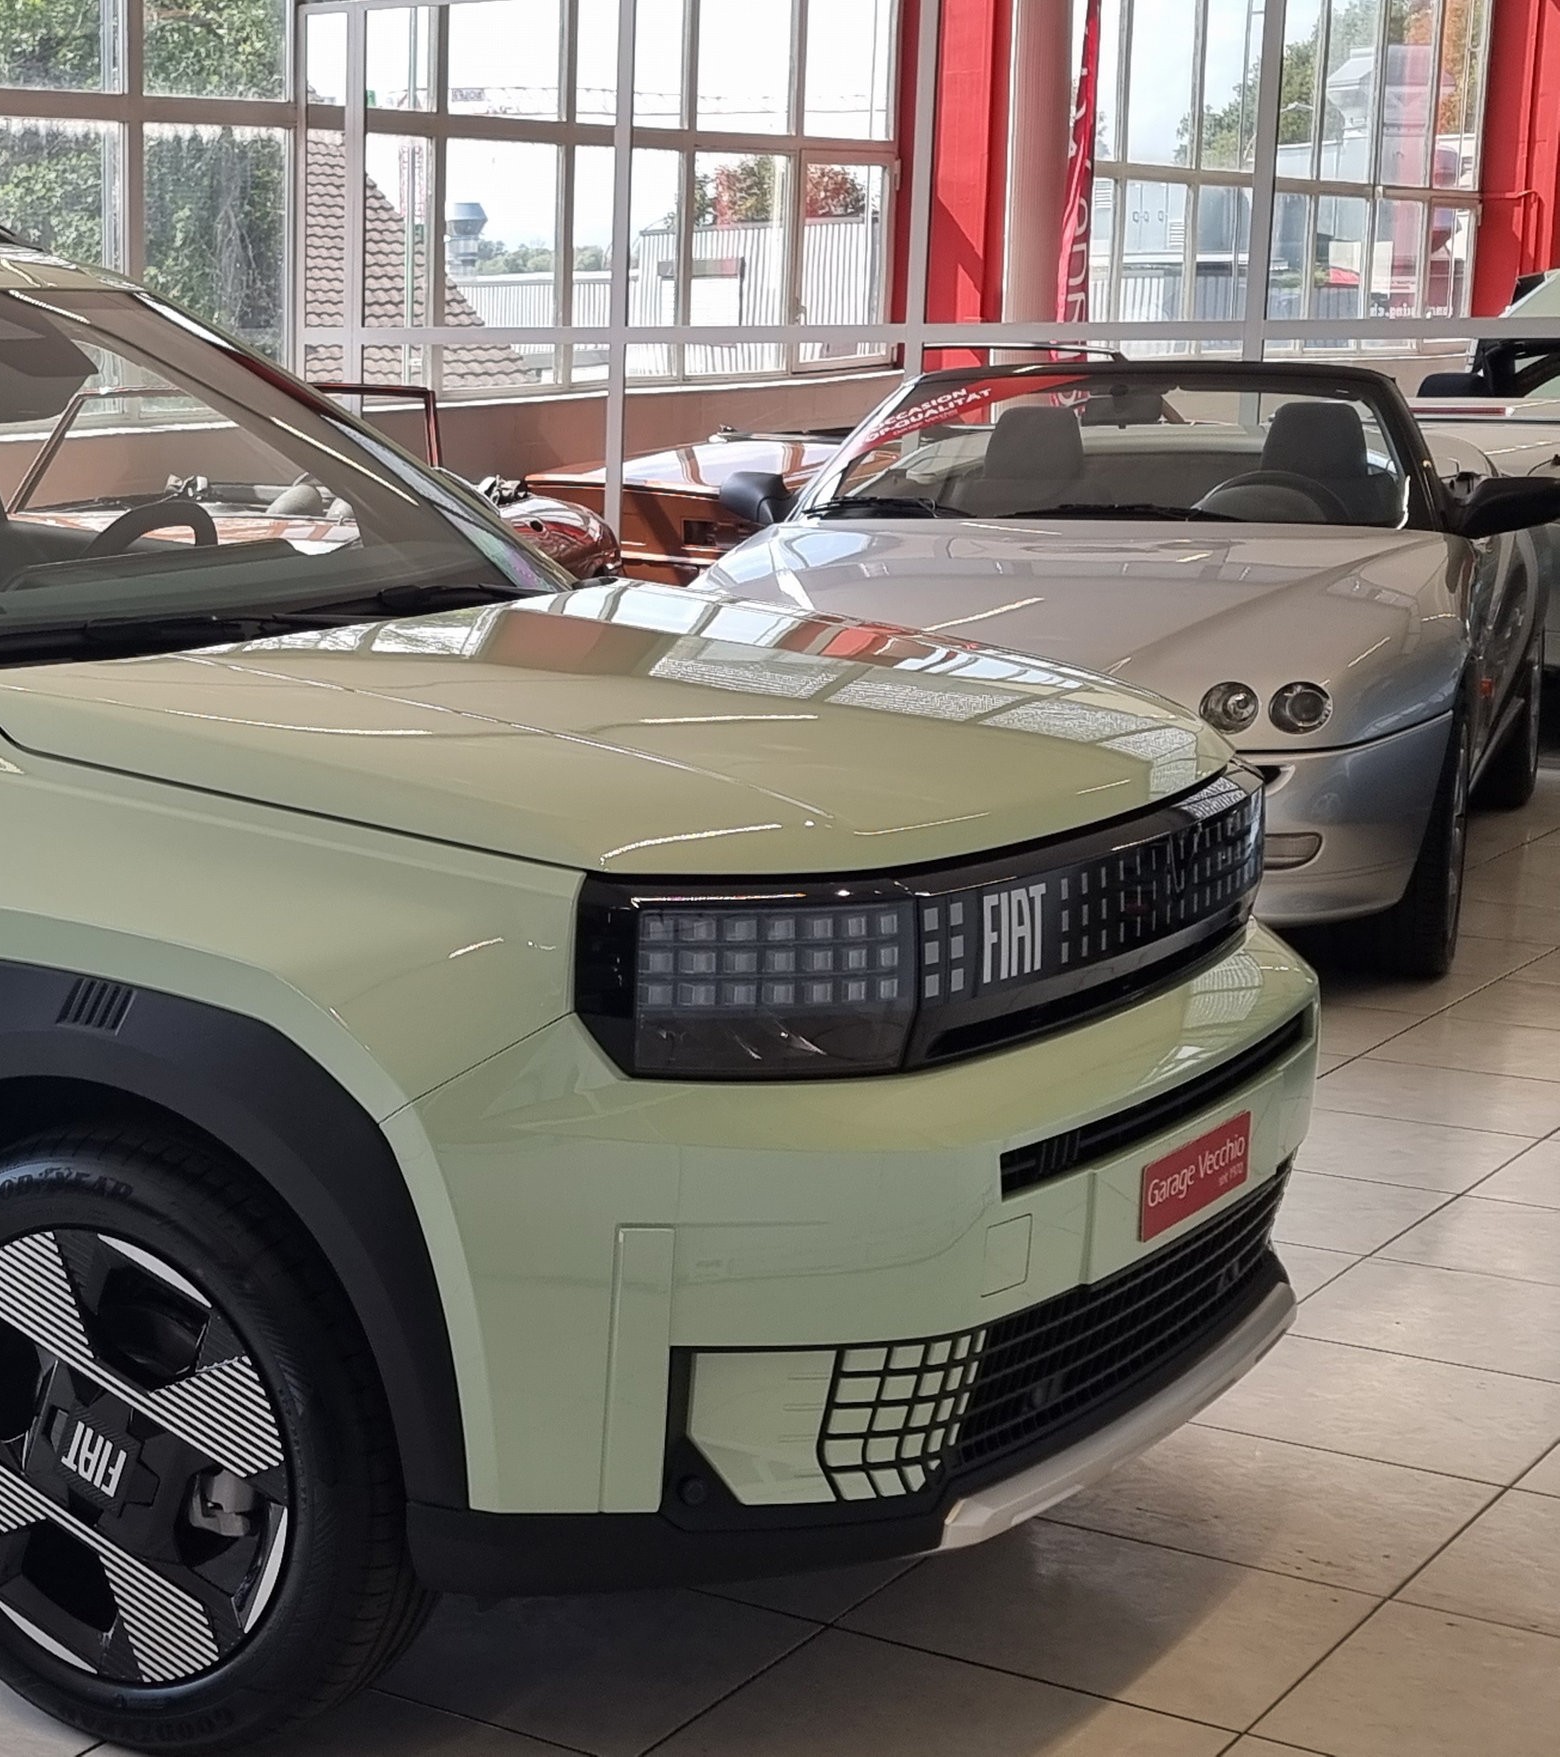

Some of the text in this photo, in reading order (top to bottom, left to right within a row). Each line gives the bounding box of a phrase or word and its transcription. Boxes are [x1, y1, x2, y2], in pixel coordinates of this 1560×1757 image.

[983, 883, 1046, 984] FIAT
[1147, 1134, 1246, 1207] Garage Vecchio
[61, 1420, 127, 1498] FIAT
